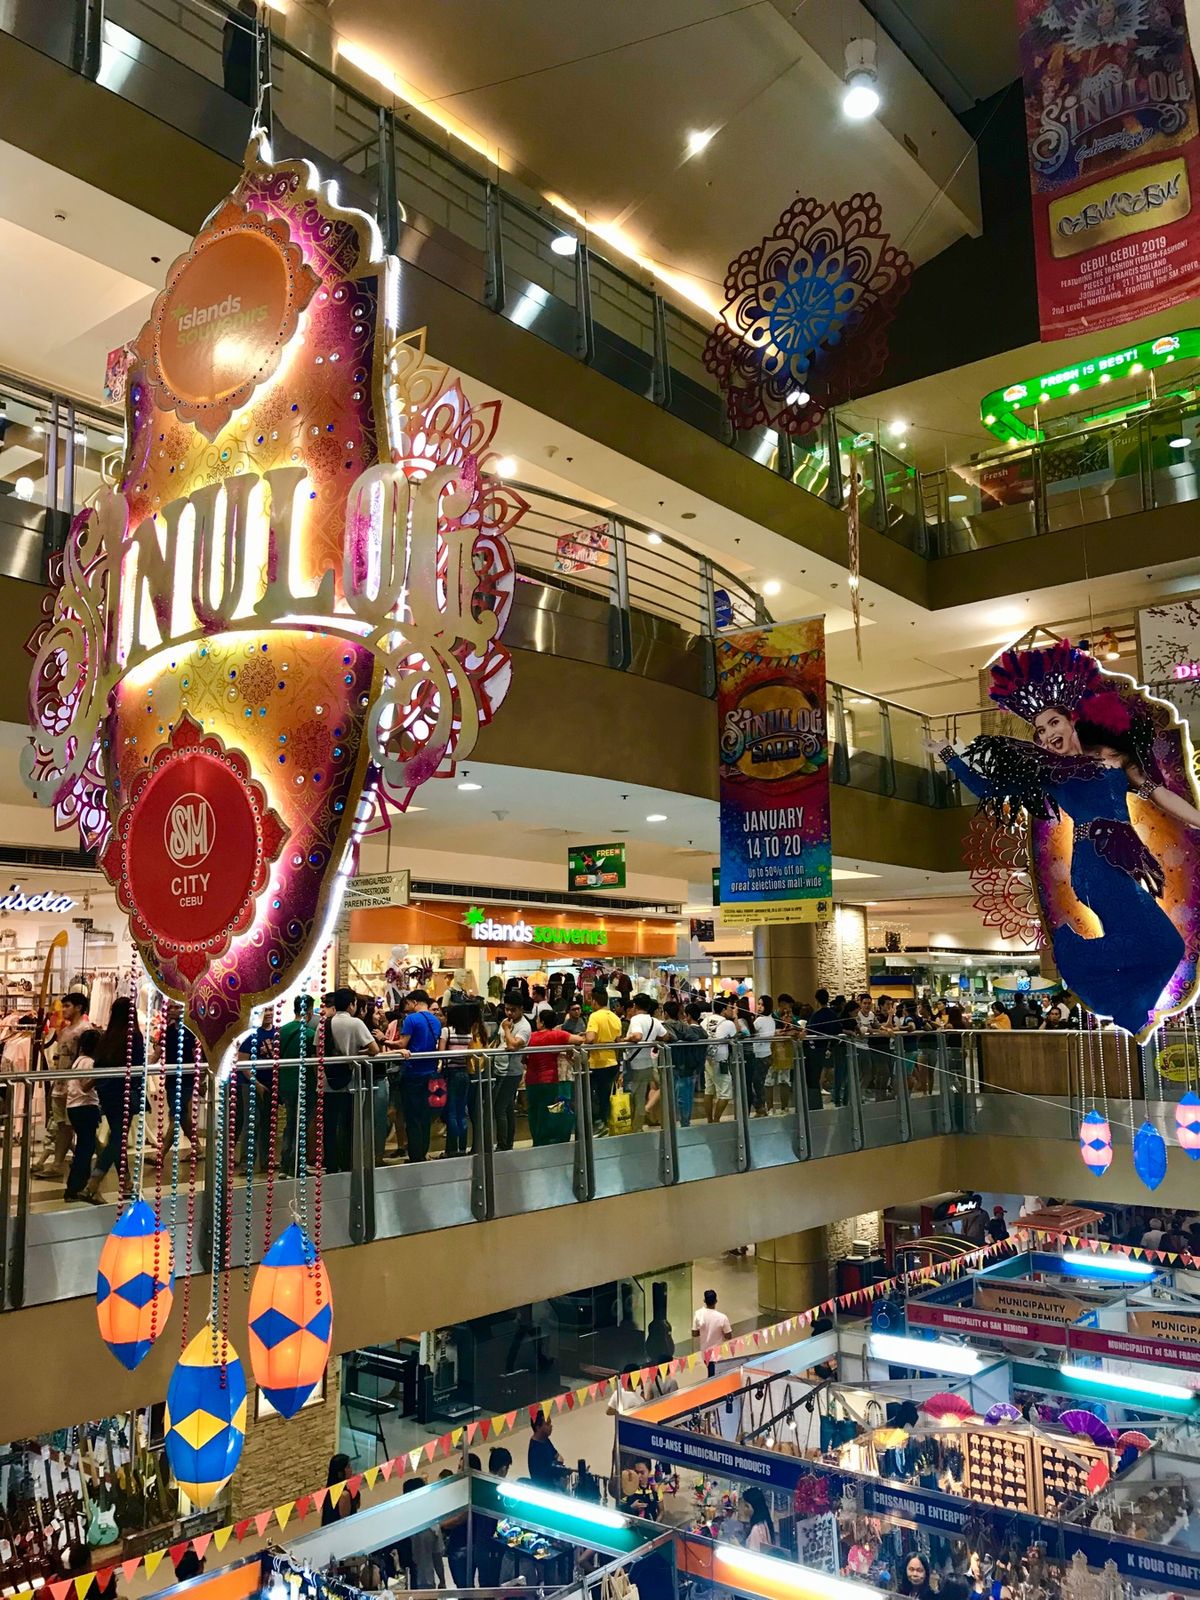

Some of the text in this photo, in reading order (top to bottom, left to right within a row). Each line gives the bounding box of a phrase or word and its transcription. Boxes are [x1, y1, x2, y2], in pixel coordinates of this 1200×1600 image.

[1080, 236, 1167, 274] CEBU! CEBU! 2019
[1060, 274, 1093, 288] FEATURING
[1093, 270, 1104, 280] THE
[1105, 262, 1134, 277] TRASHION
[1079, 287, 1106, 300] January
[1122, 279, 1130, 288] 21
[1136, 274, 1151, 284] Mall
[1153, 264, 1173, 278] Hours
[1083, 280, 1104, 291] PIECES
[1104, 277, 1112, 285] OF
[1113, 268, 1139, 282] FRANCIS
[1052, 305, 1065, 315] 2nd
[1125, 282, 1154, 296] Fronting
[1155, 275, 1167, 285] The
[1168, 269, 1179, 280] SM
[178, 294, 241, 331] islands
[177, 304, 268, 347] souvenirs
[1041, 350, 1138, 388] FRESH IS BEST!
[1114, 435, 1139, 447] Pure
[983, 470, 1009, 481] Fresh
[752, 740, 801, 764] SALE
[170, 802, 208, 860] SM
[743, 807, 804, 832] JANUARY
[596, 849, 615, 857] FREE
[747, 834, 801, 859] 14 TO 20
[747, 865, 805, 879] Up to 50% off on
[171, 873, 211, 896] CITY
[730, 876, 822, 893] great selections mall-wide
[179, 896, 204, 907] CEBU
[344, 897, 391, 908] PARENTS ROOM
[474, 919, 608, 945] islands souvenirs
[998, 1296, 1065, 1314] MUNICIPALITY
[943, 1314, 1028, 1335] MUNICIPALITY of SAN REMIGIO
[1152, 1319, 1200, 1335] MUNICIP
[1108, 1340, 1154, 1355] MUNICIPALITY
[1163, 1348, 1178, 1359] SAN
[651, 1435, 771, 1476] GLO-ANSE HANDICRAFTED PRODUCTS
[873, 1492, 925, 1514] CRISSANDER
[1127, 1553, 1135, 1567] K
[1138, 1555, 1165, 1574] FOUR
